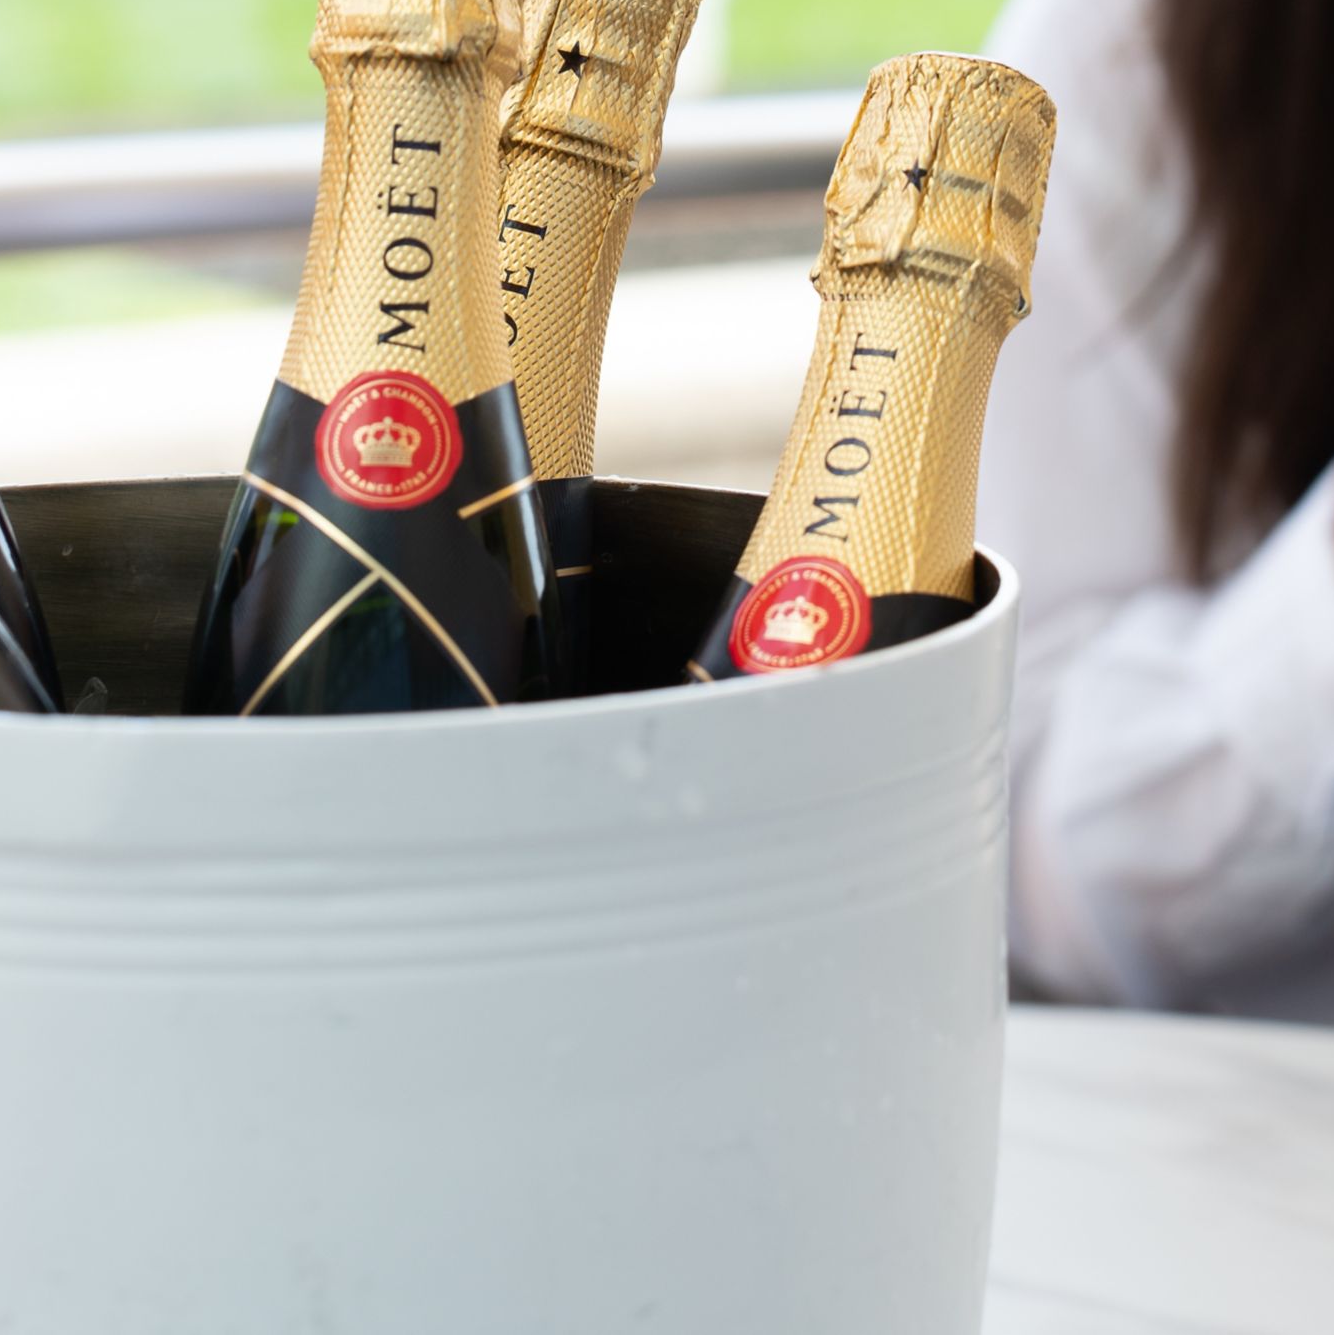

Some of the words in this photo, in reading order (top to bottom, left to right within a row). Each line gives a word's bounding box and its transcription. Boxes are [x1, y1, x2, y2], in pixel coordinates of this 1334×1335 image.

[377, 124, 441, 354] MOËT
[382, 386, 438, 425] CHANDON
[803, 332, 898, 543] MOËT
